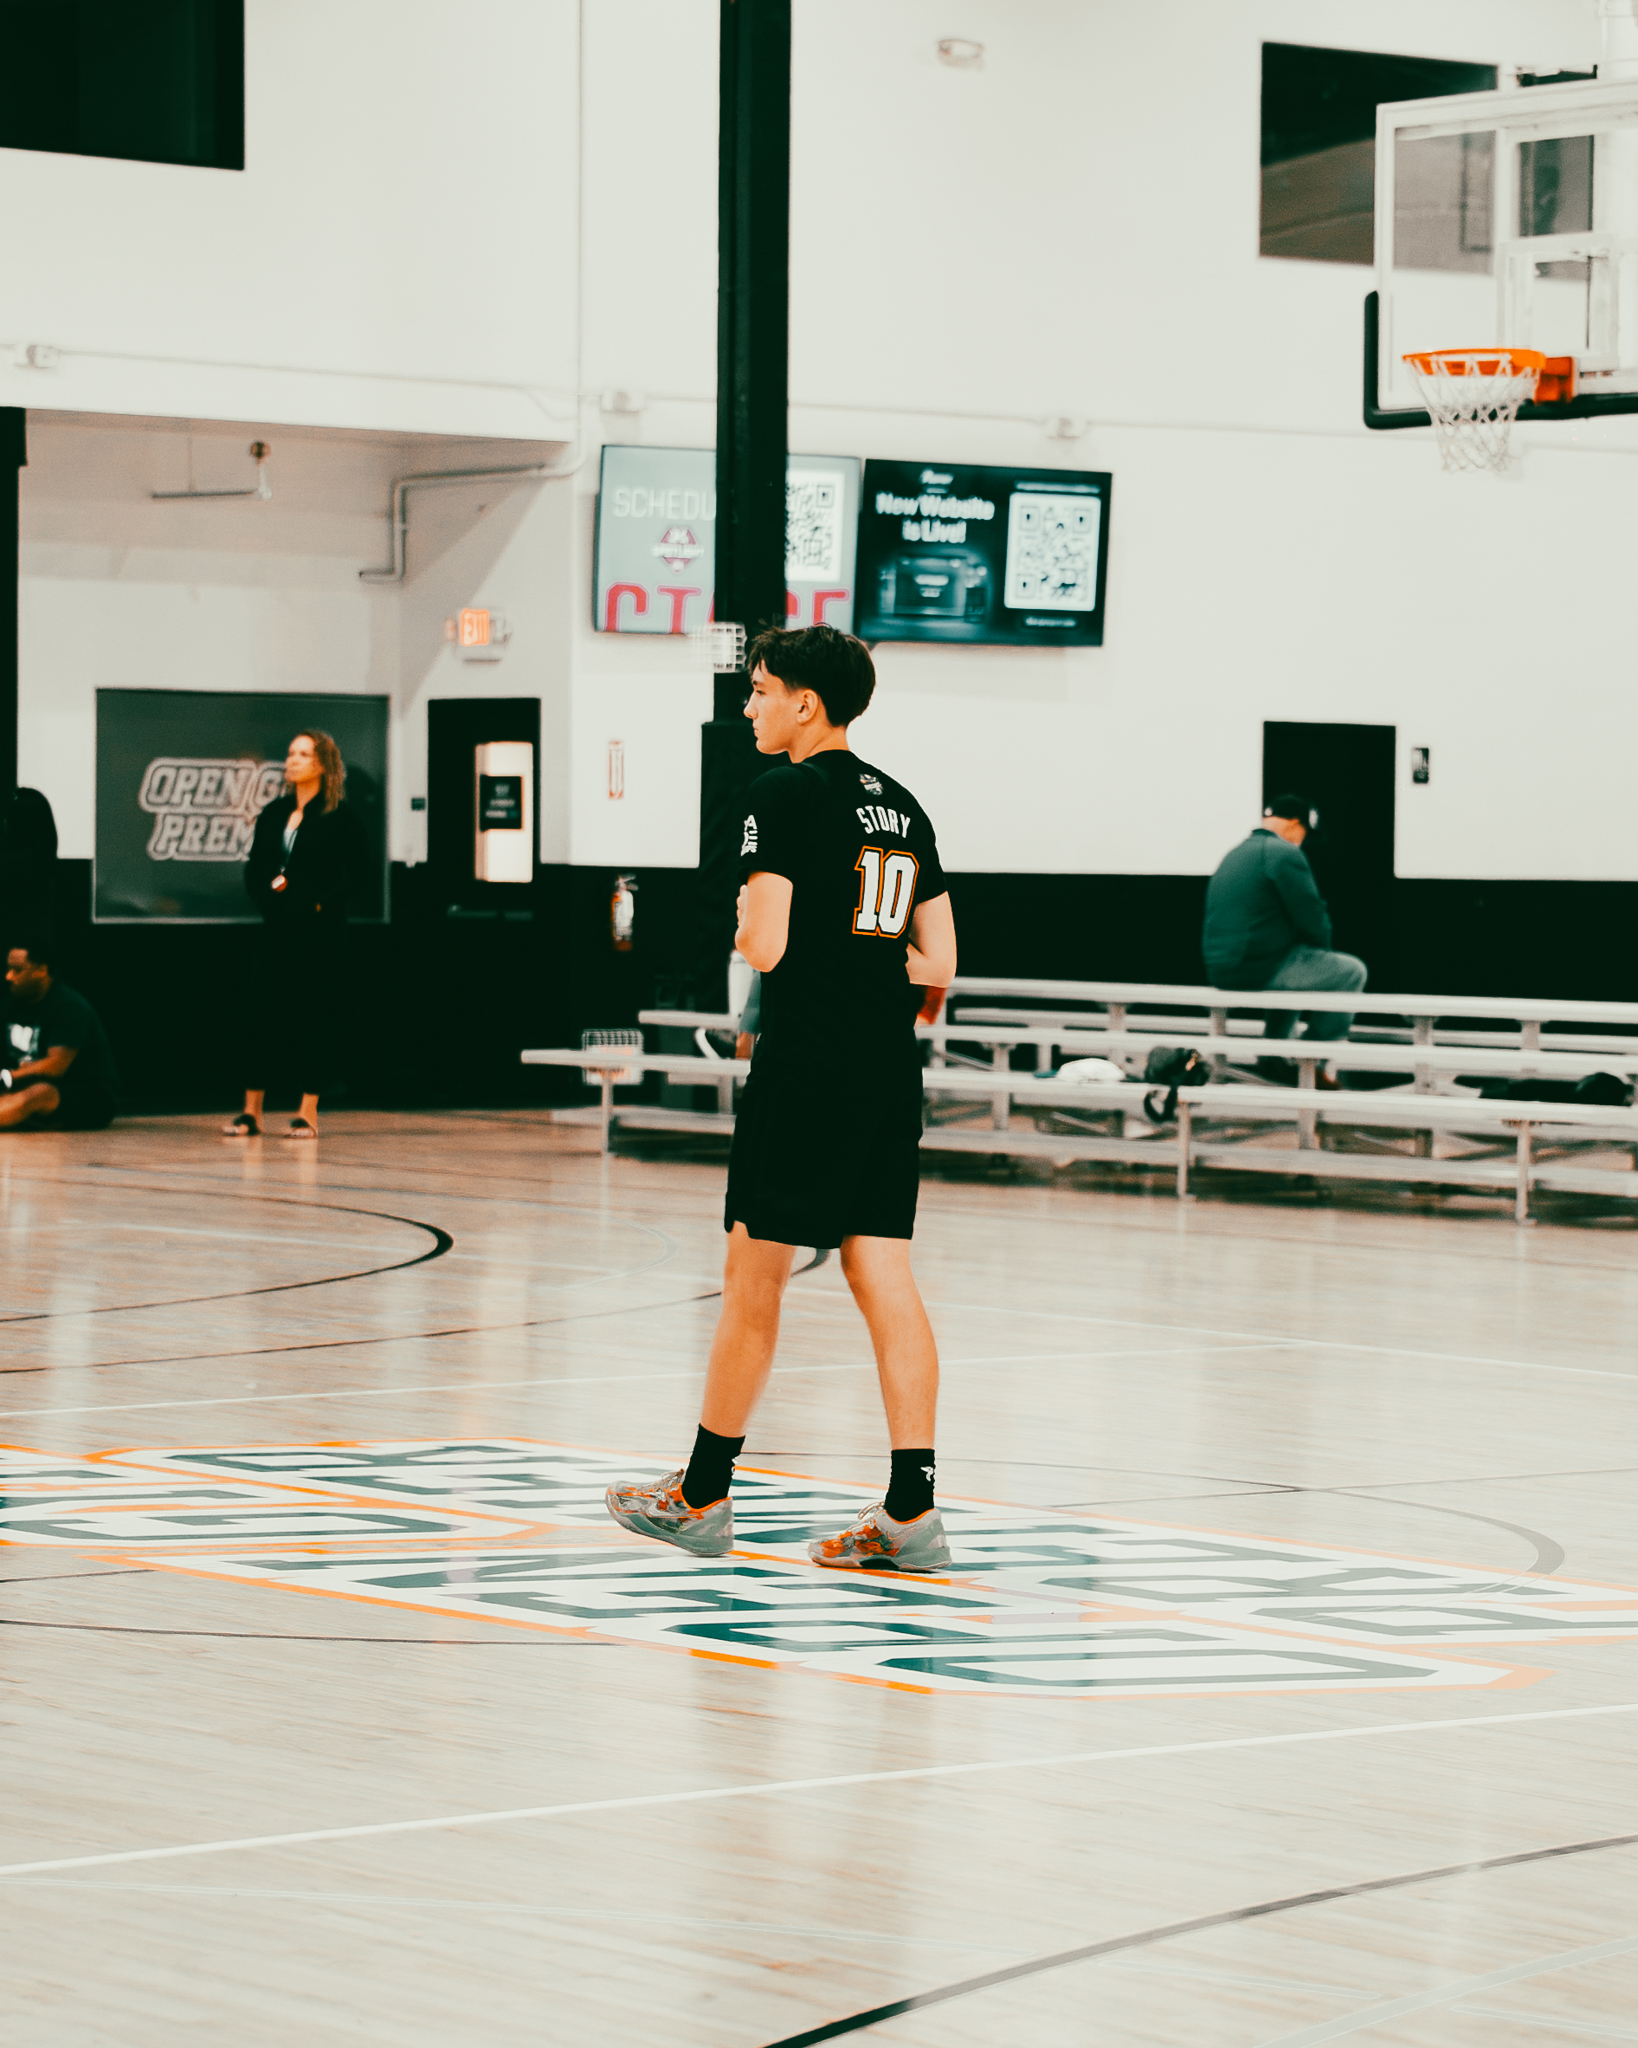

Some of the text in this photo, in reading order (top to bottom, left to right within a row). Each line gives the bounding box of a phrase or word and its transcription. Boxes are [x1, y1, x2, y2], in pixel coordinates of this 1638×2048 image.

[876, 492, 918, 516] New
[144, 764, 252, 808] OPEN
[856, 805, 911, 838] STORY
[852, 845, 920, 938] 10
